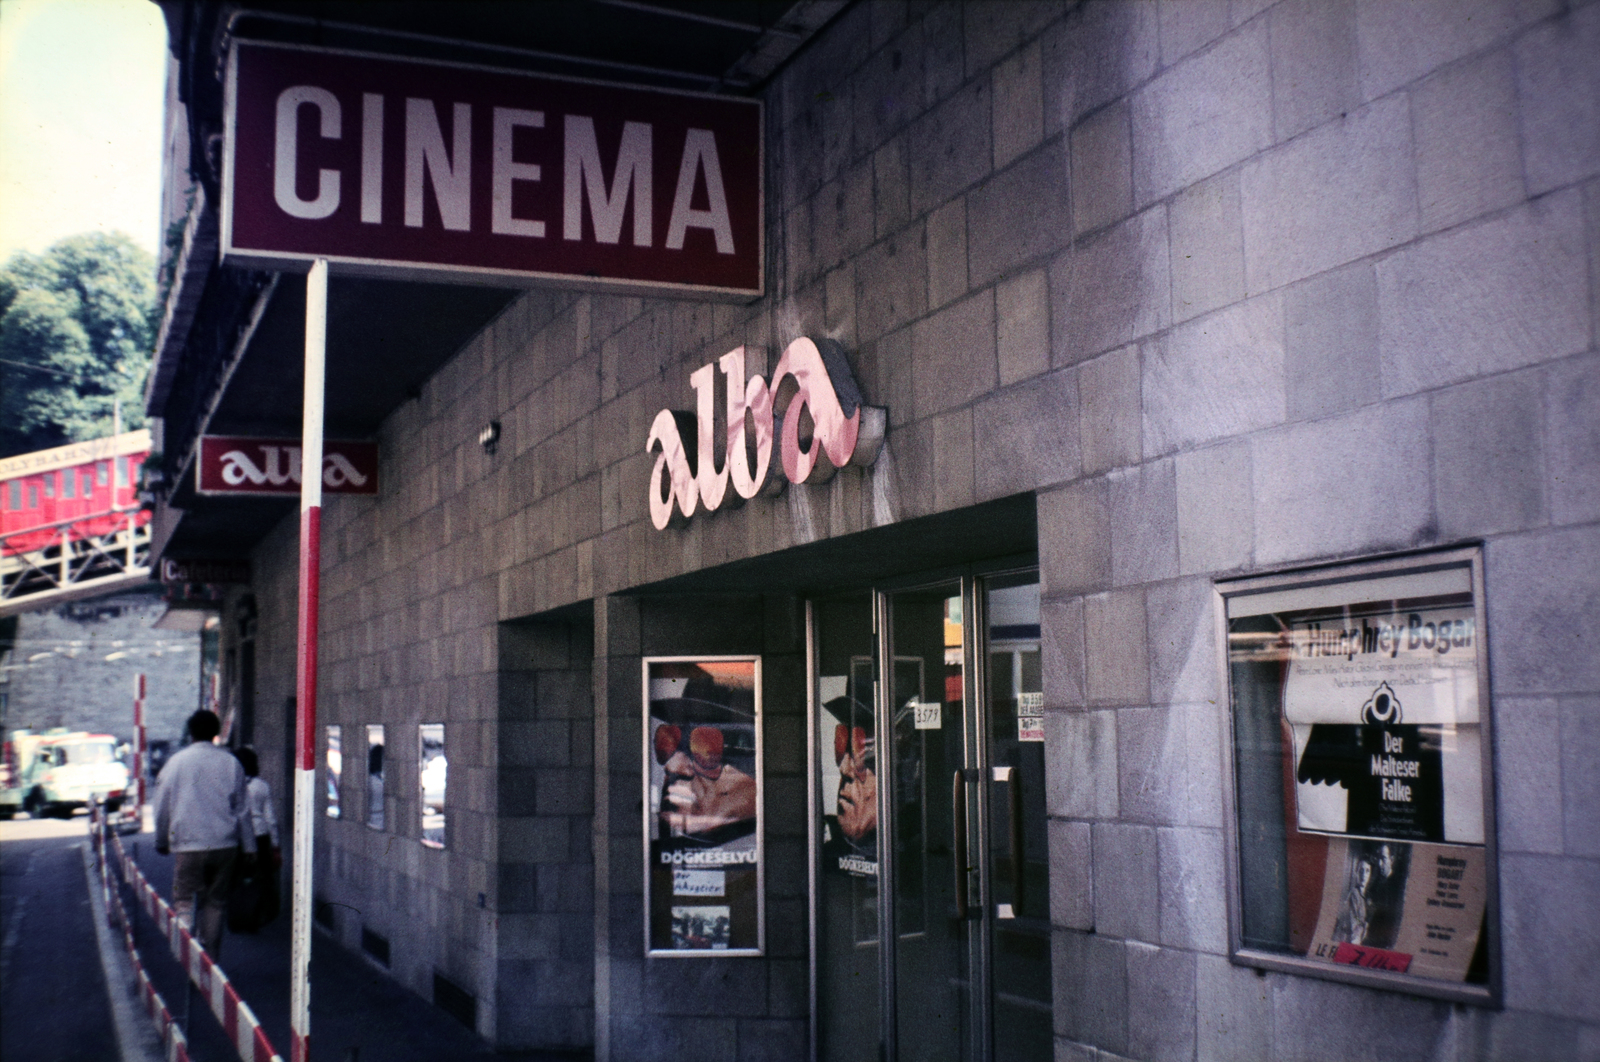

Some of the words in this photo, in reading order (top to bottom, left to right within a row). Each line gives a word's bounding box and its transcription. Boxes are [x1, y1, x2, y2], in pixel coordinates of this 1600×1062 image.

[273, 84, 736, 255] CINEMA
[646, 336, 860, 531] alba
[1307, 617, 1404, 661] Humphrey
[1384, 731, 1403, 753] Der
[1371, 754, 1420, 778] Malteser
[1382, 778, 1412, 802] Falke
